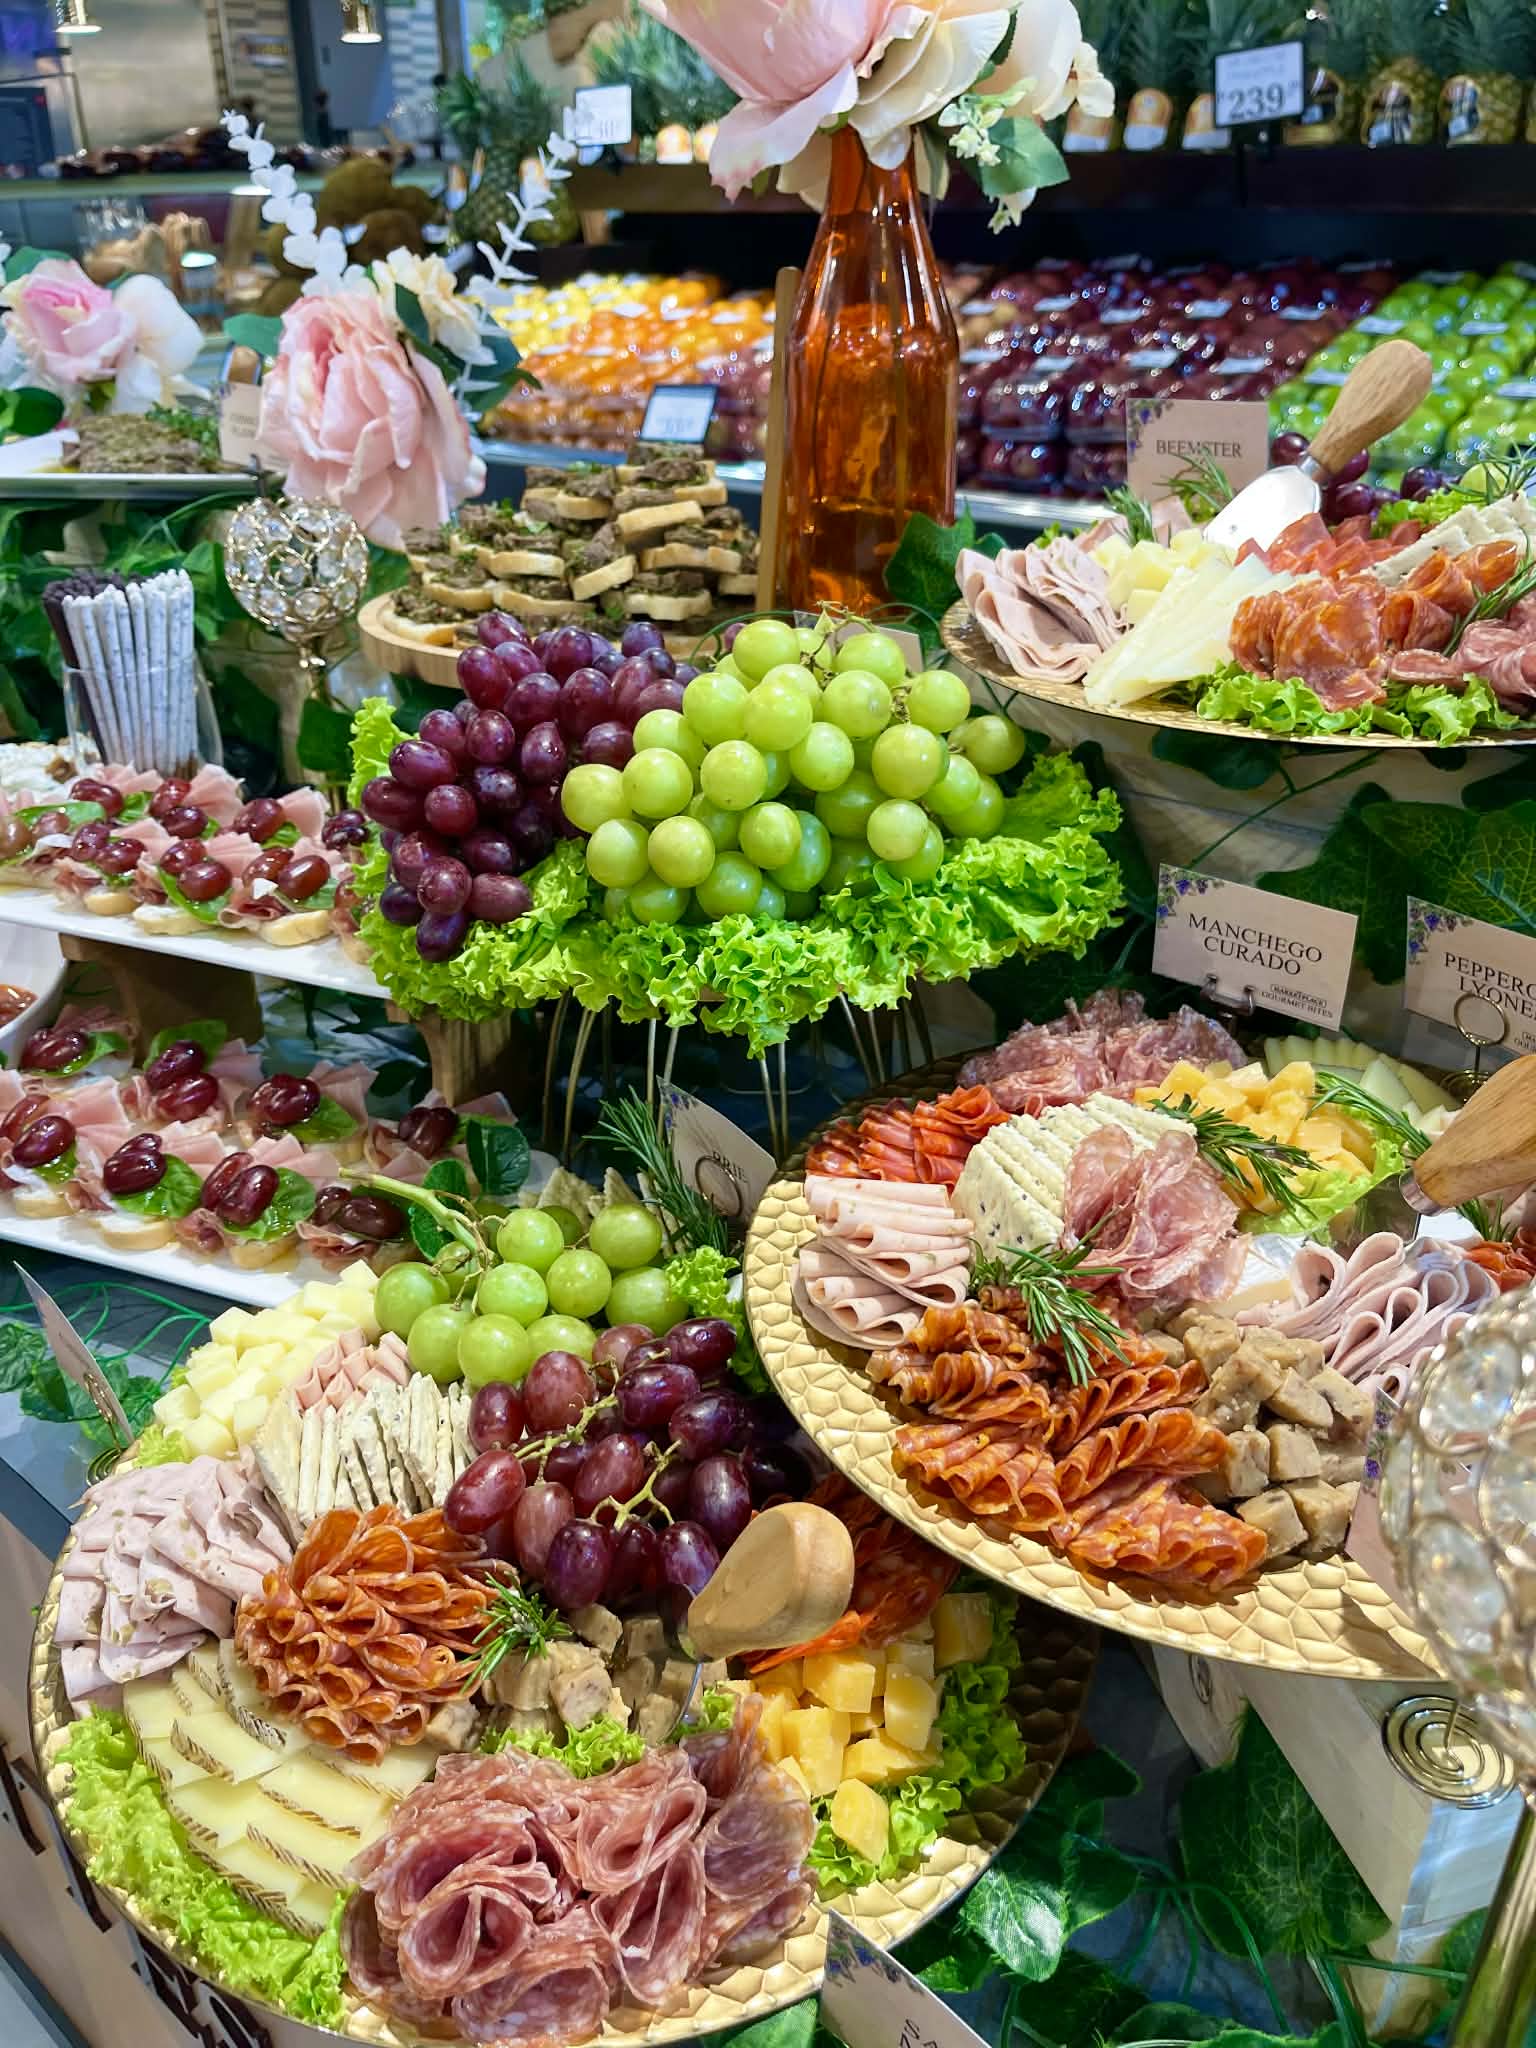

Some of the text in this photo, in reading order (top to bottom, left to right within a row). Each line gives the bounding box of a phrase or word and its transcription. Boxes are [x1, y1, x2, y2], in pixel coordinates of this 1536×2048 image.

[1155, 439, 1243, 459] BEEMSTER
[1188, 912, 1323, 963] MANCHEGO
[1203, 935, 1301, 976] CURADO
[1459, 975, 1536, 1021] LYONE
